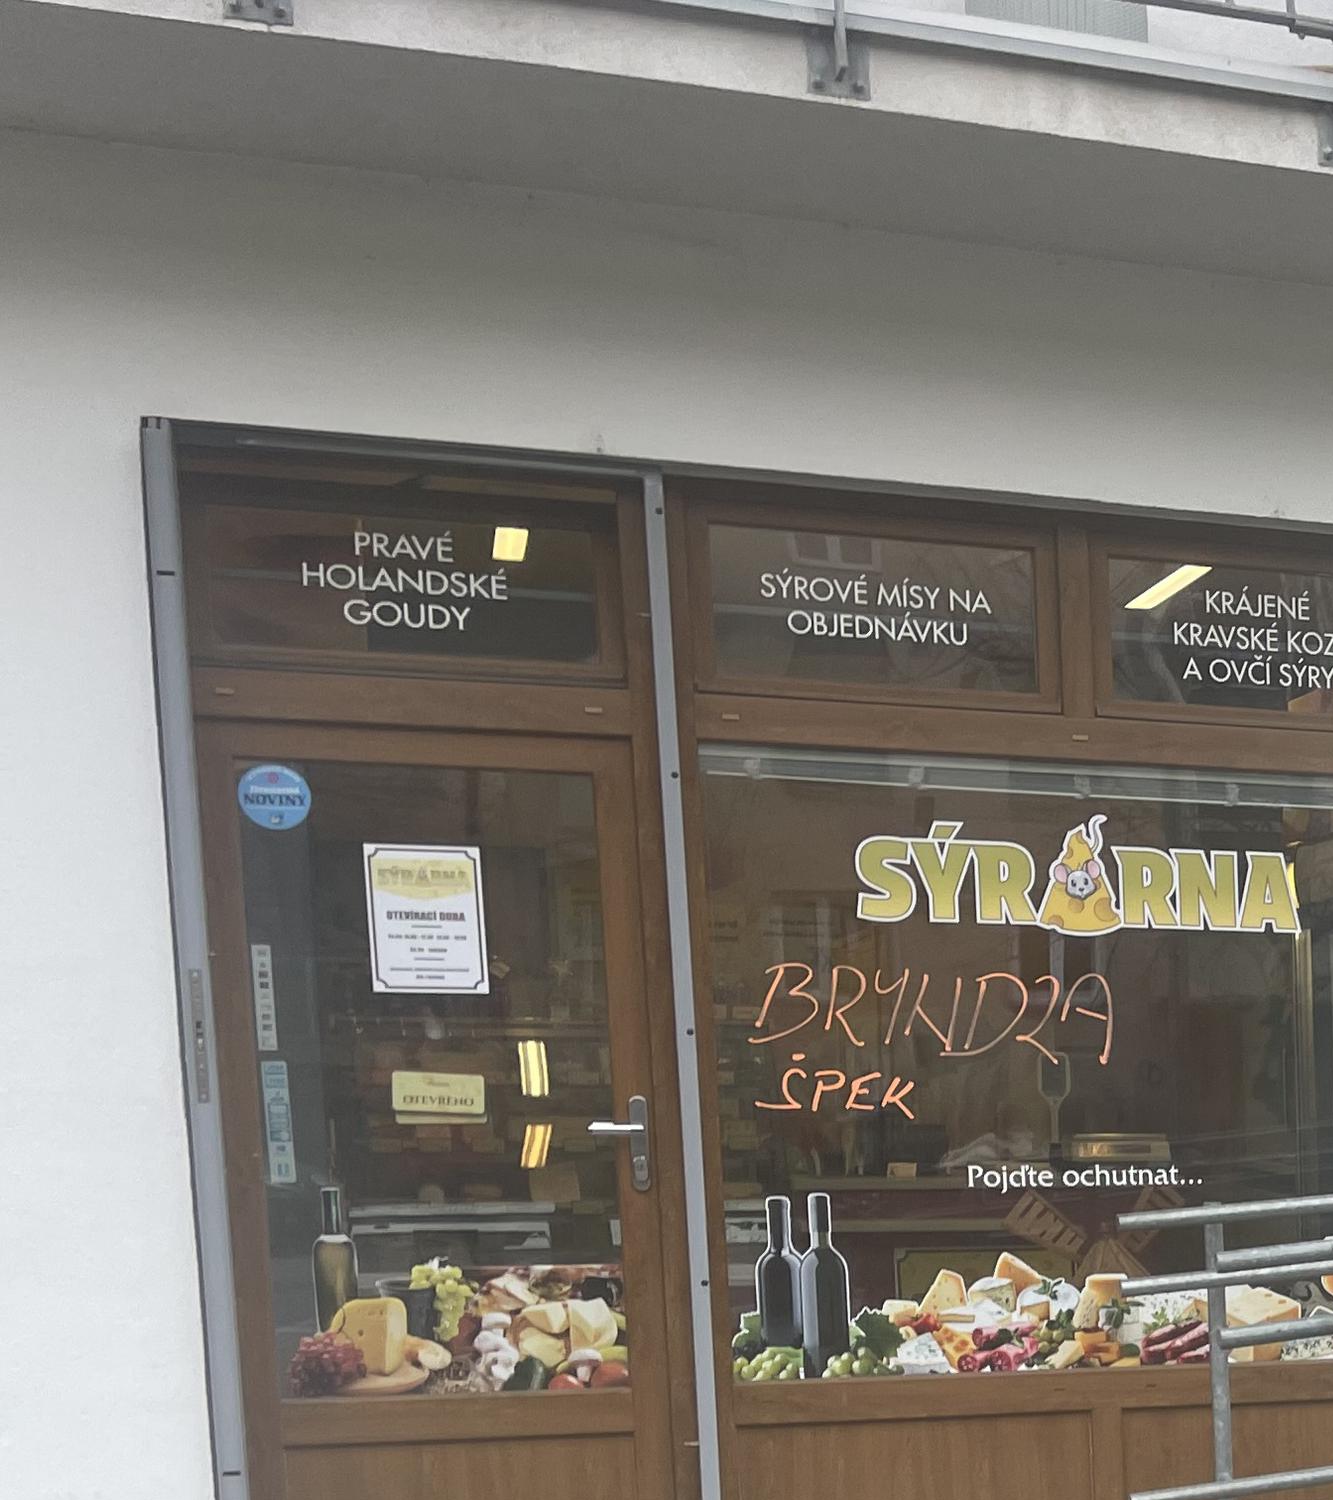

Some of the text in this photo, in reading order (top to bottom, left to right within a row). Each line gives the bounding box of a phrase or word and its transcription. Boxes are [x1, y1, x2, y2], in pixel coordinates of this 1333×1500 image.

[354, 530, 454, 562] PRAVÉ
[302, 562, 508, 600] HOLANDSKÉ
[760, 568, 992, 614] SÝROVÉ MÍSY NA
[343, 599, 471, 631] GOUDY
[1205, 586, 1310, 621] KRÁJENÉ
[787, 610, 968, 646] OBJEDNÁVKU
[1173, 621, 1279, 652] KRAVSKÉ
[1182, 657, 1203, 681] A
[1209, 654, 1272, 685] OVČÍ
[243, 793, 306, 806] NOVINY
[755, 1053, 916, 1119] ŠPEK
[967, 1165, 1054, 1193] Pojďte
